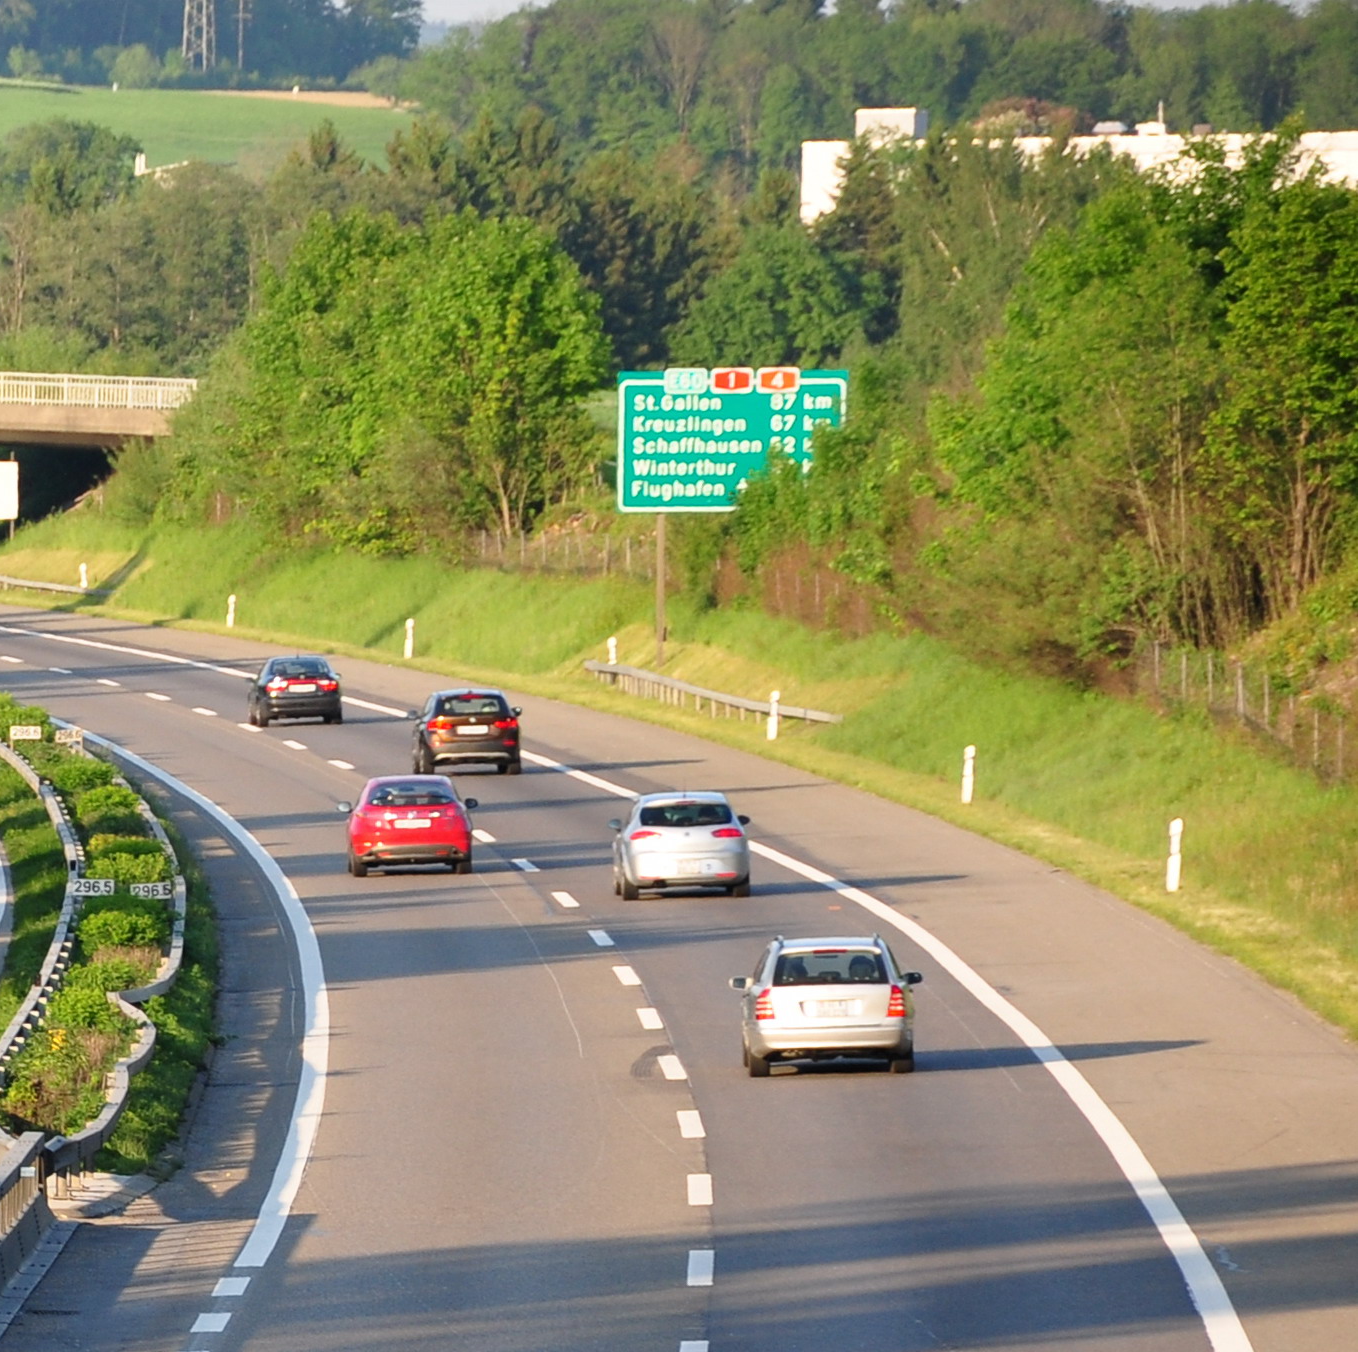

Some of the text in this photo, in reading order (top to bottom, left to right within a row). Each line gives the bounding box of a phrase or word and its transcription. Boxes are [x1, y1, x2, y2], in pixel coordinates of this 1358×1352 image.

[667, 371, 701, 390] E60
[728, 371, 736, 388] 1
[770, 371, 784, 388] 4
[802, 393, 833, 410] km
[632, 414, 747, 436] Kreuzlingen
[770, 414, 796, 431] 67
[632, 436, 763, 454] Schaffhausen
[632, 458, 737, 476] Winterthur
[631, 480, 726, 502] Flughafen
[74, 880, 112, 894] 296.5
[132, 884, 172, 897] 296.5
